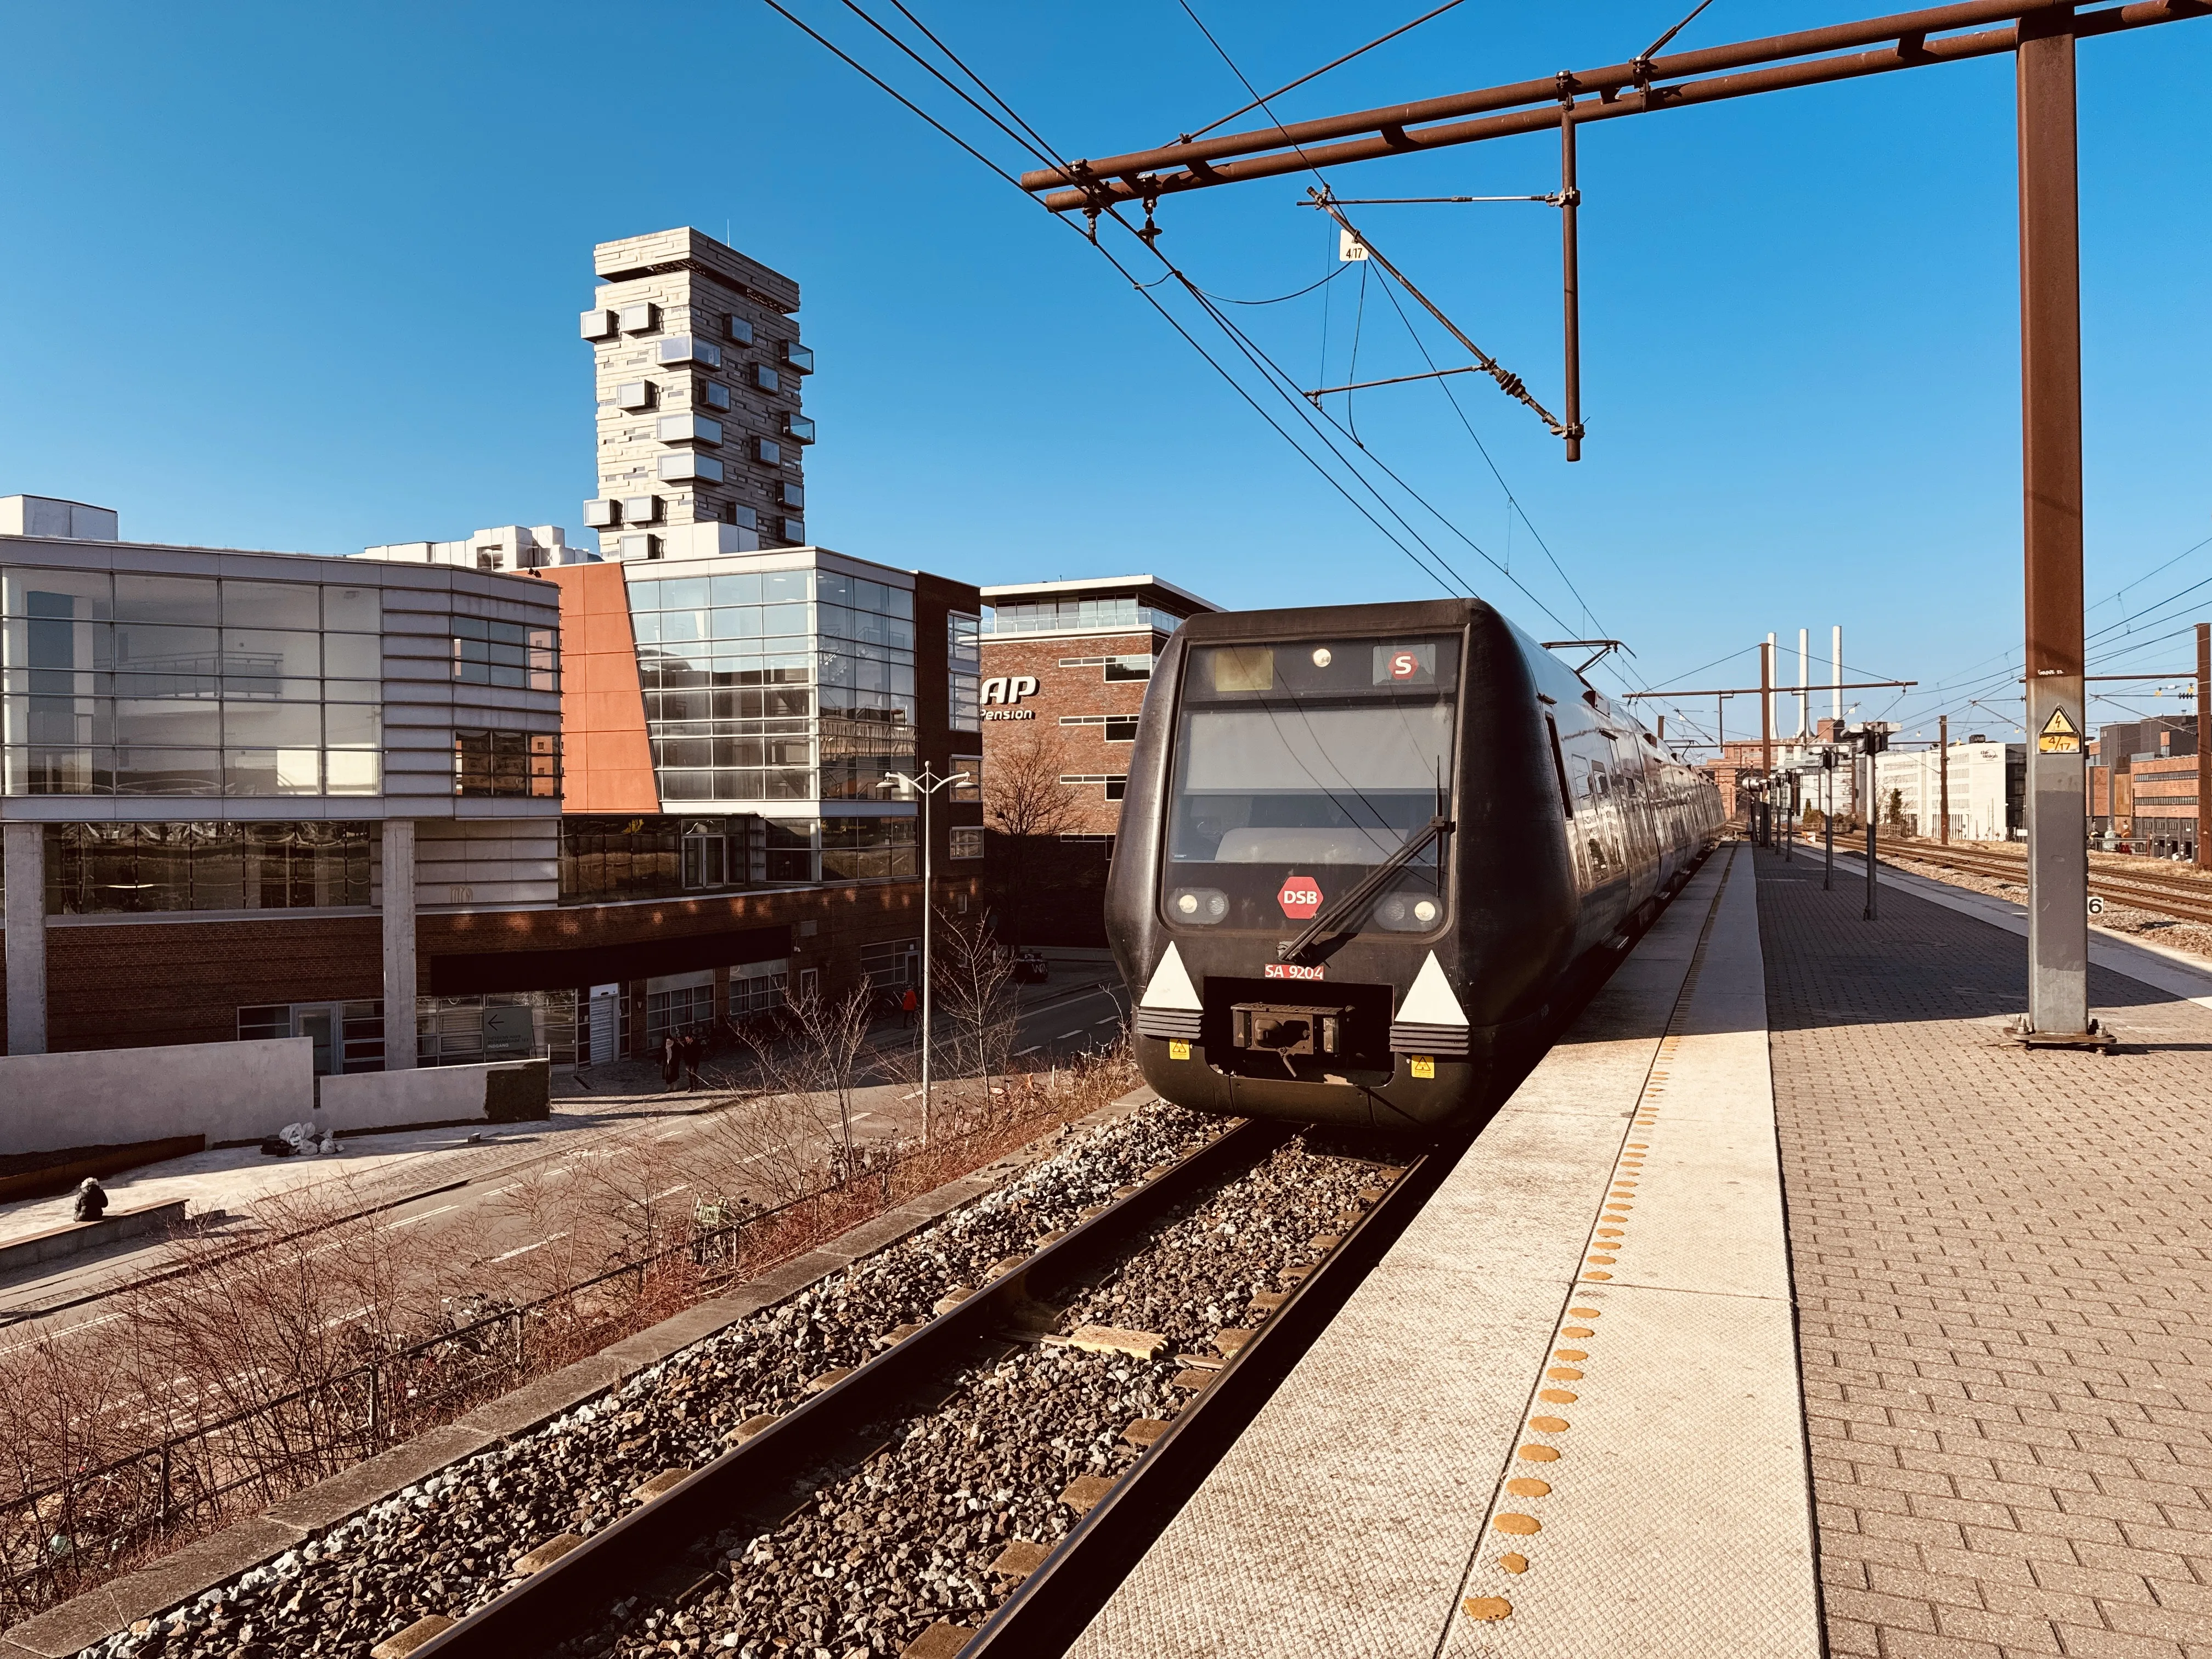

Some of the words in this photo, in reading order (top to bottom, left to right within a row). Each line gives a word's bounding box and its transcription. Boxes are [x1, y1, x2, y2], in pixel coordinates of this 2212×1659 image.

[1346, 247, 1363, 259] 4/17
[1395, 656, 1412, 674] S
[980, 676, 1037, 705] AP
[2048, 737, 2071, 751] 4/17
[1284, 890, 1317, 904] DSB
[2089, 898, 2102, 914] 6
[1265, 964, 1284, 978] SA
[1289, 965, 1323, 979] 9204
